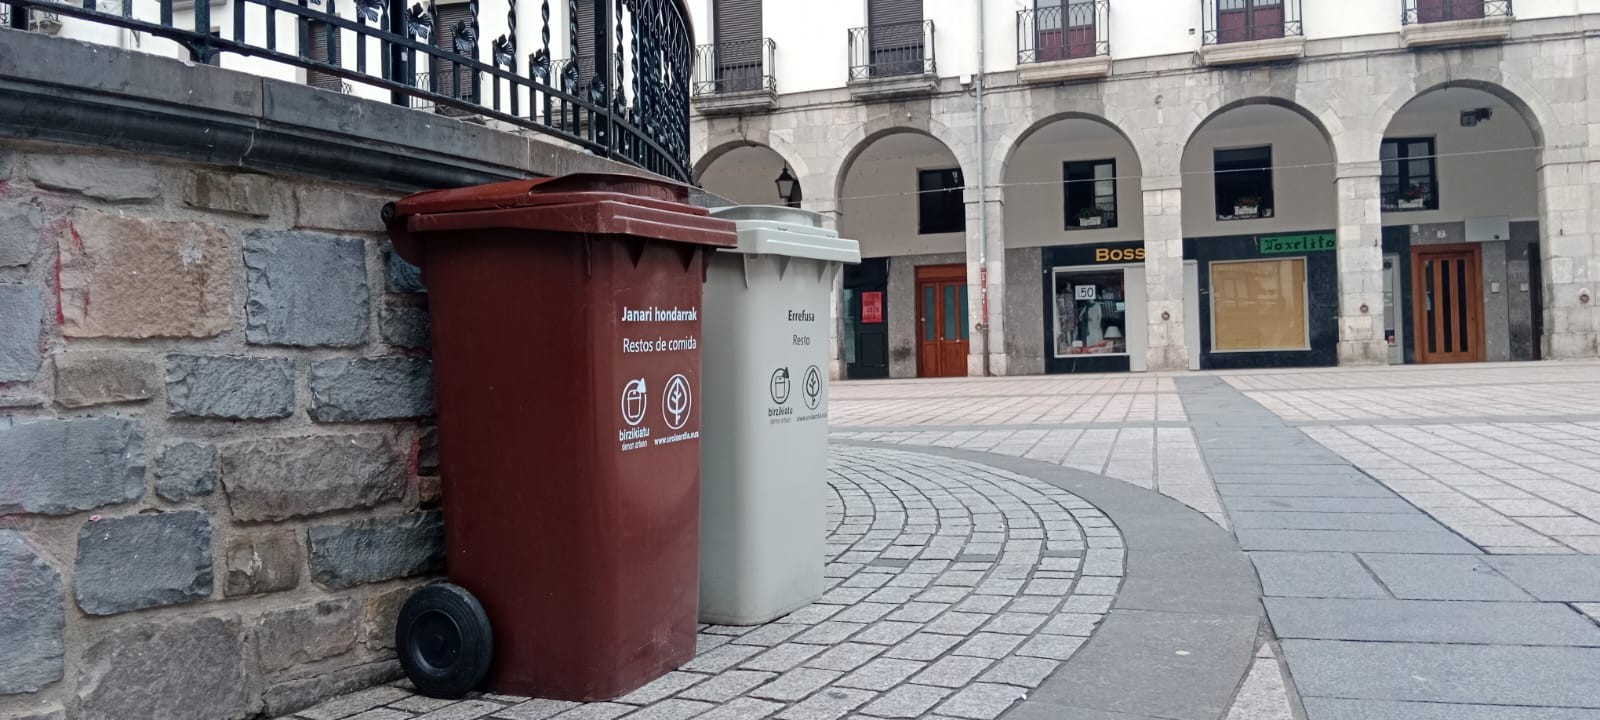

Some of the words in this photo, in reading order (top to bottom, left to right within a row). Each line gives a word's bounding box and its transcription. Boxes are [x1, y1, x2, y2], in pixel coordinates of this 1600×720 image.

[621, 306, 652, 321] Janari
[654, 306, 697, 321] hondarrak
[788, 309, 815, 322] Errefusa
[623, 337, 653, 353] Restos
[655, 336, 667, 352] de
[668, 335, 697, 351] comida
[792, 334, 811, 346] Resto
